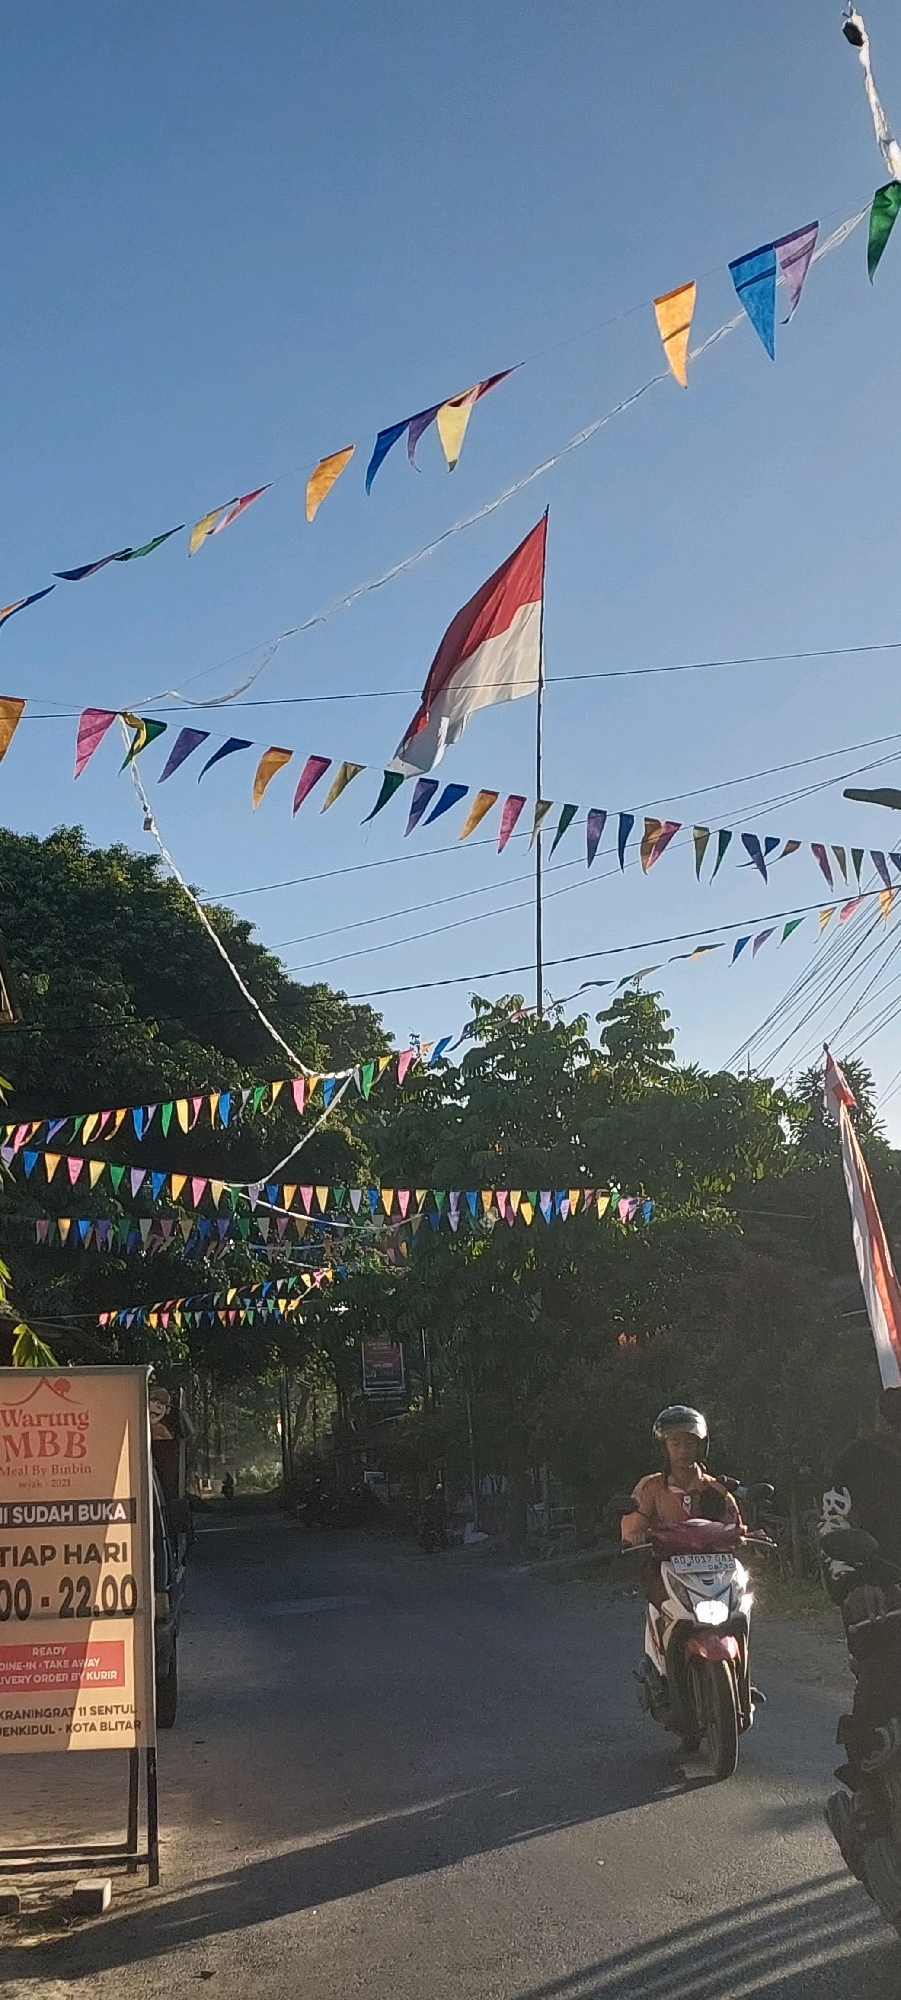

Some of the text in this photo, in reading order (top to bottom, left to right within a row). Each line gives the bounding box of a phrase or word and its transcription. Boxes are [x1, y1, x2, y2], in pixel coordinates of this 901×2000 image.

[0, 1409, 89, 1430] Warung
[3, 1430, 86, 1462] MBB
[0, 1463, 92, 1478] Meal By Binbin
[51, 1479, 71, 1488] 2021
[12, 1504, 74, 1524] SUDAH
[78, 1503, 127, 1521] BUKA
[0, 1542, 128, 1567] TIAP HARI
[58, 1574, 138, 1618] 22.00
[32, 1646, 67, 1656] READY
[43, 1659, 69, 1669] TAKE
[71, 1657, 101, 1668] AWAY
[33, 1672, 69, 1684] ORDER
[70, 1671, 85, 1681] BY
[86, 1670, 118, 1681] KURIR
[89, 1704, 138, 1716] SENTUL
[65, 1722, 98, 1734] KOTA
[99, 1720, 142, 1732] BLITAR
